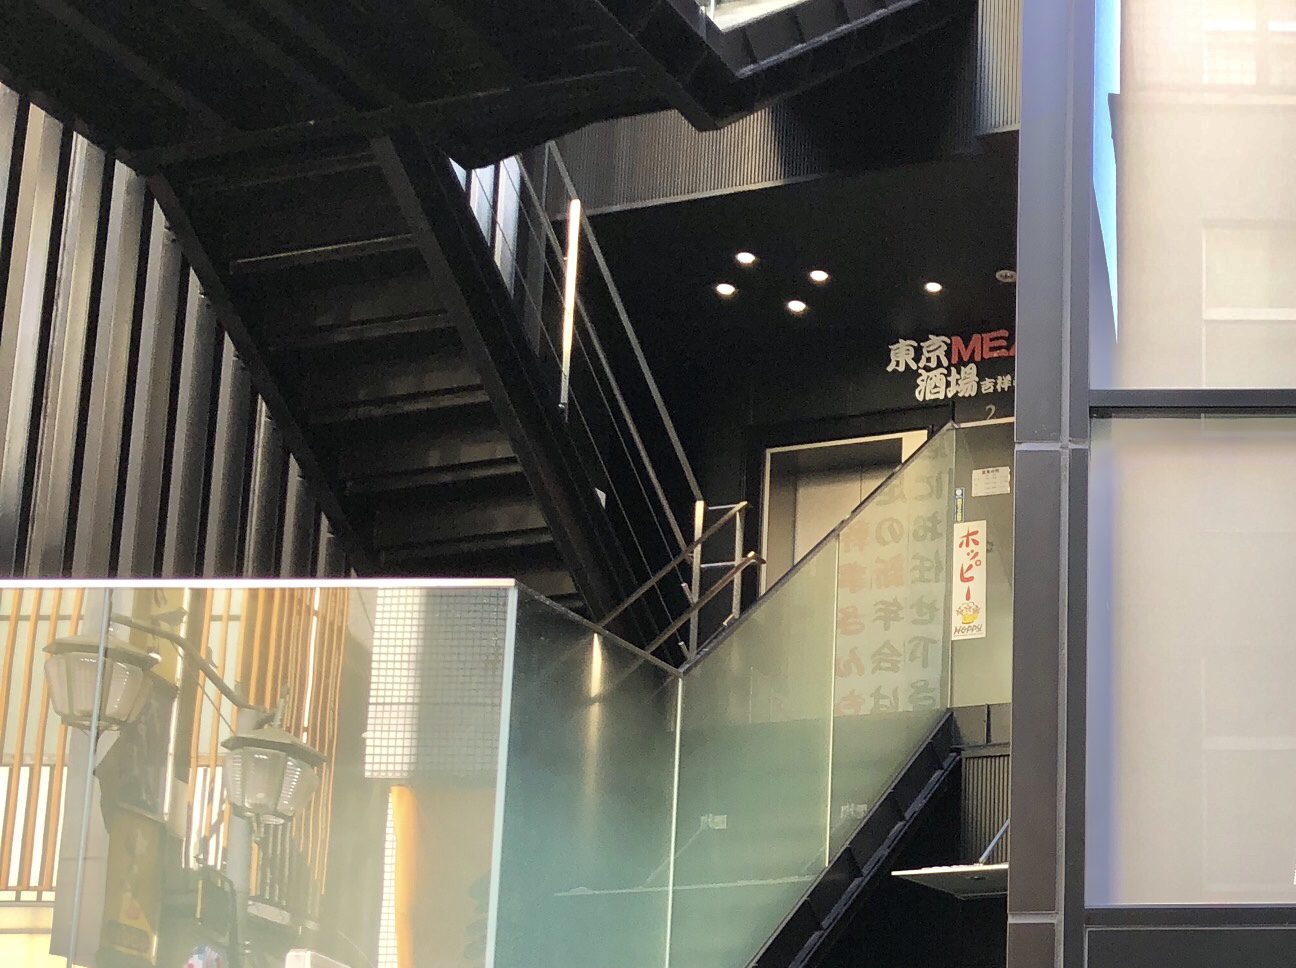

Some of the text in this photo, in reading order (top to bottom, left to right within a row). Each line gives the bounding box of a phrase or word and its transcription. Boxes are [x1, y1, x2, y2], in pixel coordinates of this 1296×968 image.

[915, 363, 1016, 402] 酒場 吉祥
[957, 526, 983, 602] ホッピー
